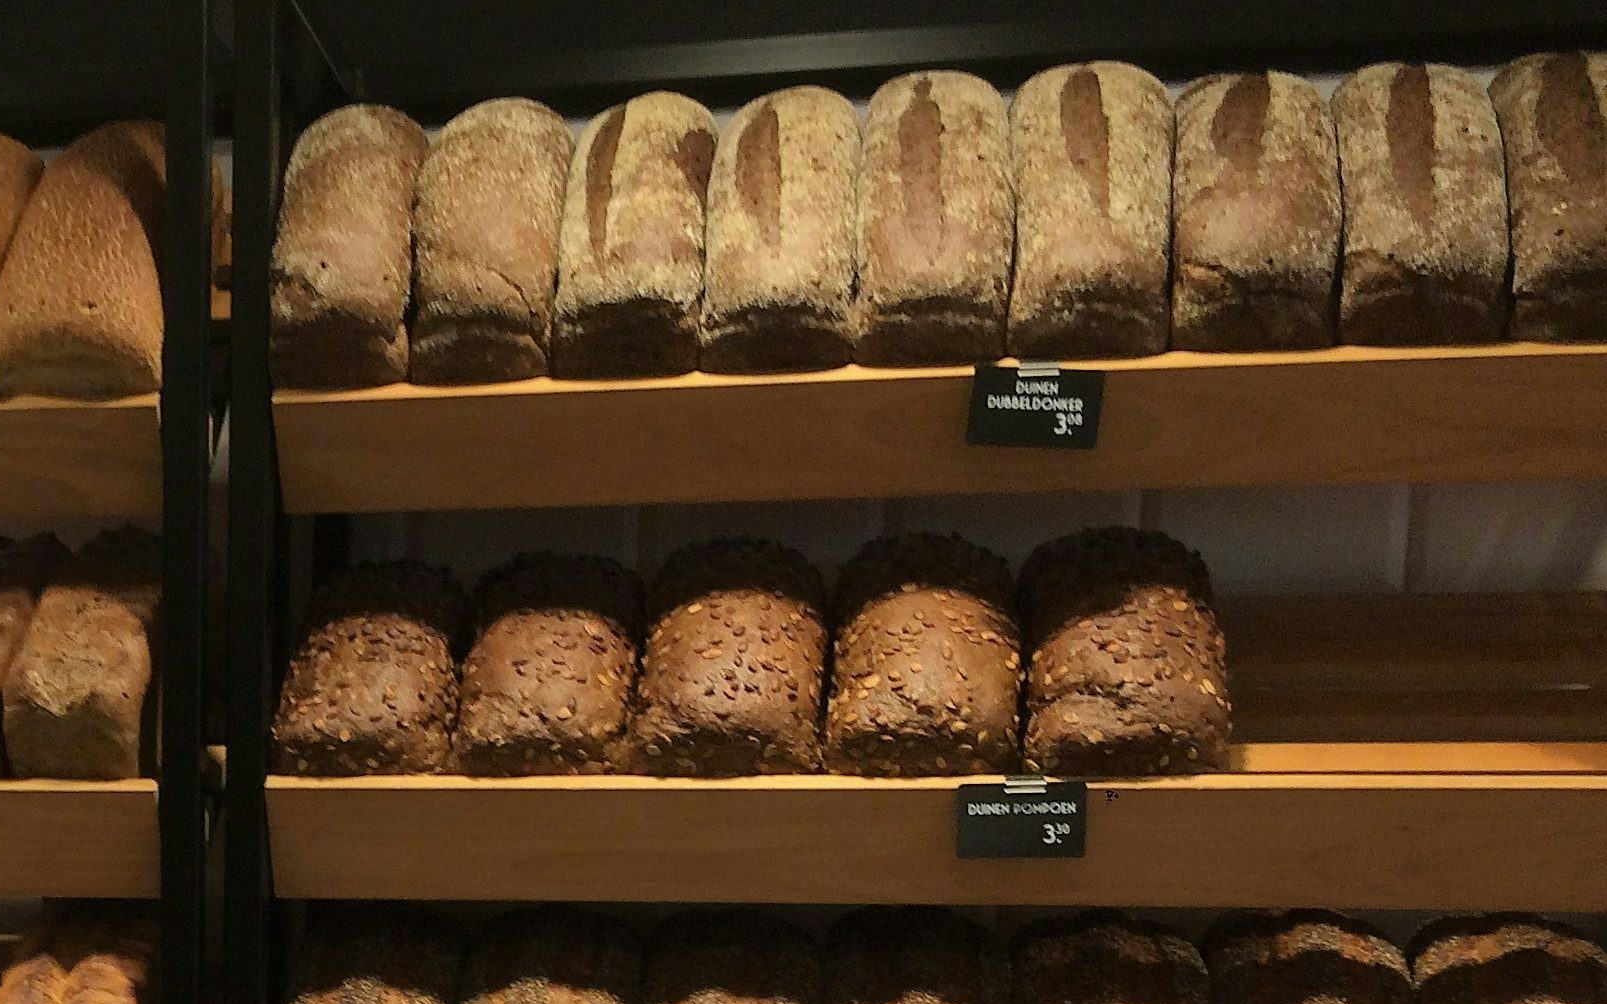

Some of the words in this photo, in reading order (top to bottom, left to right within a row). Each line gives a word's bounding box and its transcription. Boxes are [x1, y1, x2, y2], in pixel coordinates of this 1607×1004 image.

[1015, 379, 1059, 395] DUINEN
[967, 801, 1011, 816] DUINEN
[1013, 801, 1077, 815] POMPOEN
